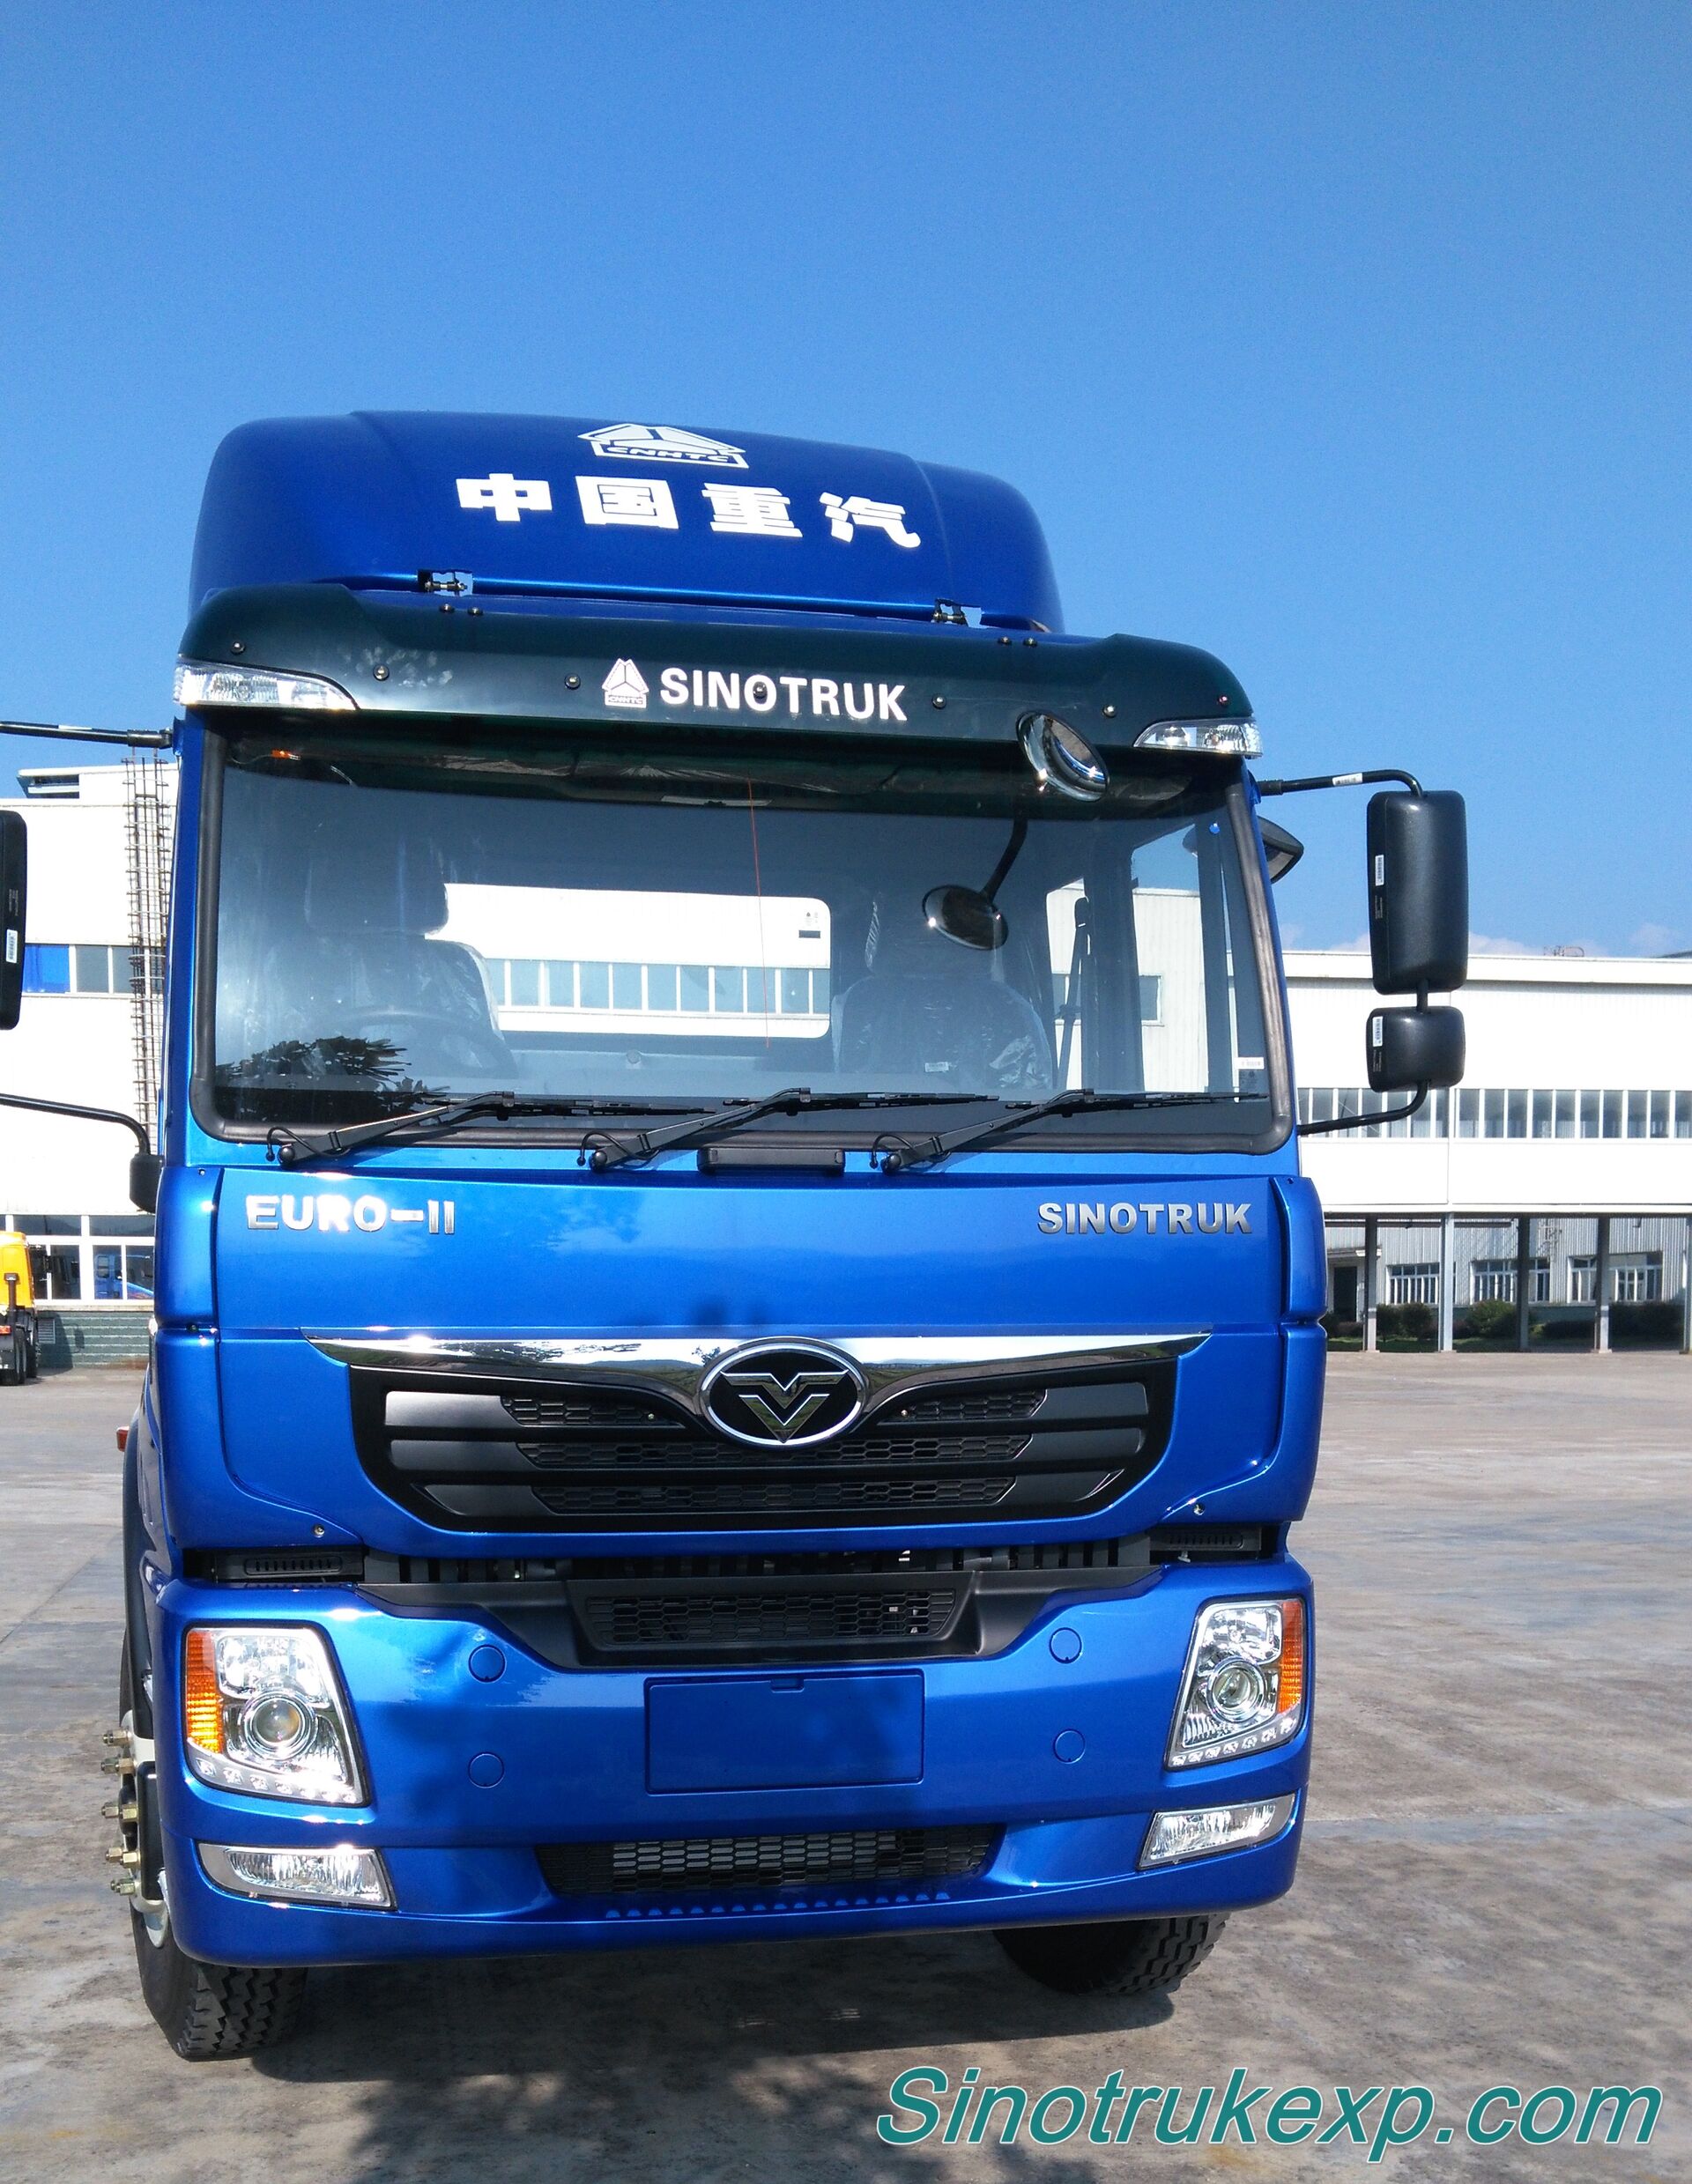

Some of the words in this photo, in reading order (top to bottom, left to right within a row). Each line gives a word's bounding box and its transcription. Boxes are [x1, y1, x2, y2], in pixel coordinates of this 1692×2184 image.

[606, 446, 731, 463] CNHTC
[456, 473, 921, 548] 中国重汽
[660, 667, 908, 722] SINOTRUK
[1037, 1202, 1253, 1234] SINOTRUK
